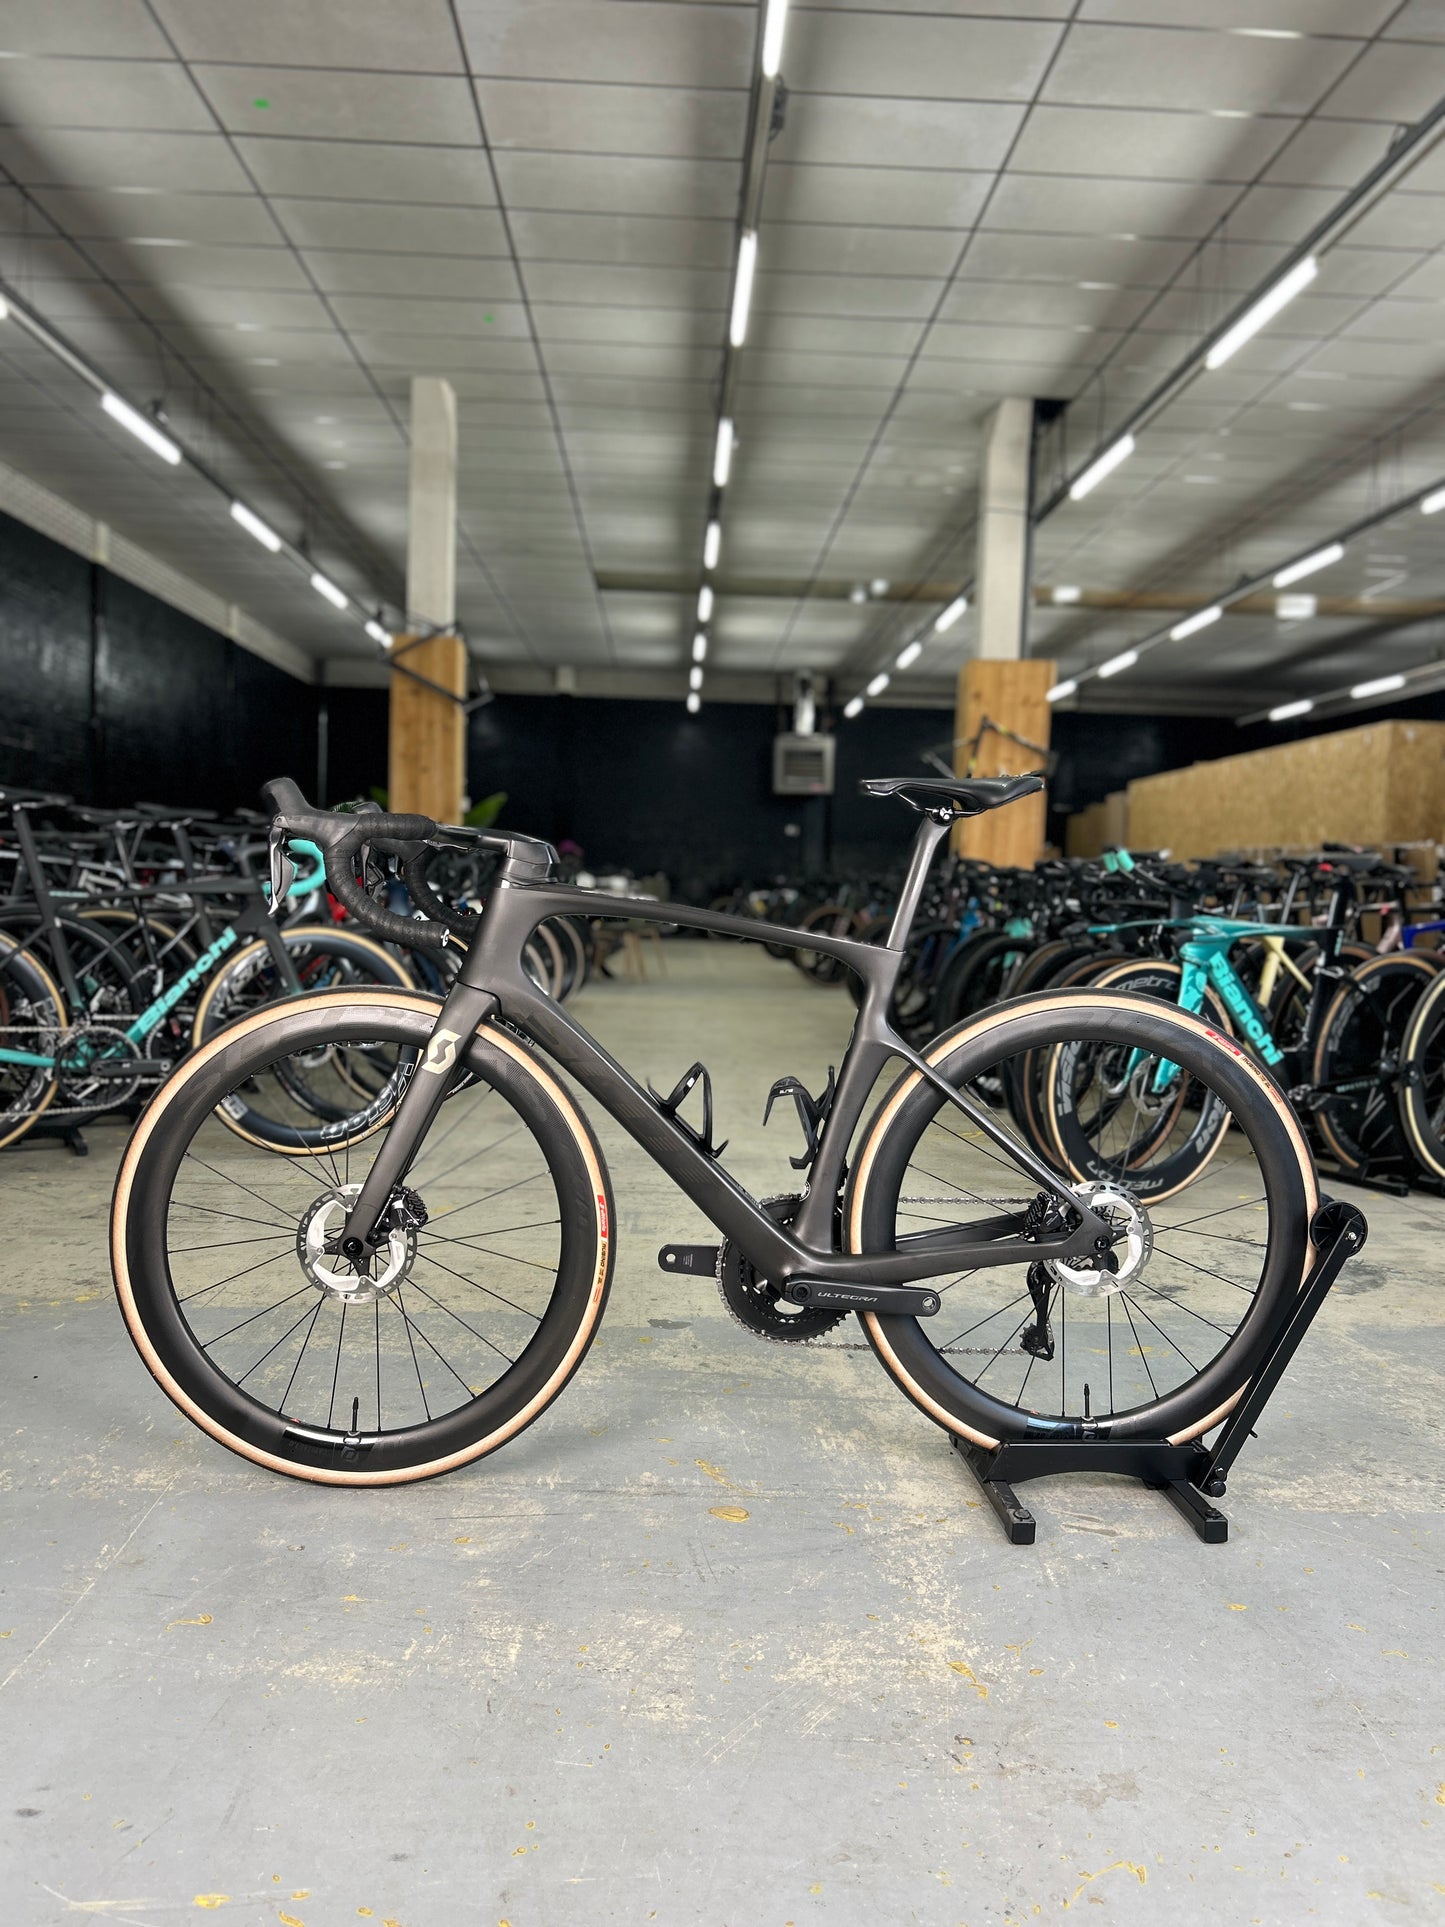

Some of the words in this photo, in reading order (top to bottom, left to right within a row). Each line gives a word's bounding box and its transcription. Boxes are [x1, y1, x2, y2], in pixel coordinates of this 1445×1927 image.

[135, 926, 238, 1035] Bianchi
[1209, 950, 1284, 1067] Bianchi
[817, 1291, 879, 1303] ULTEGRA
